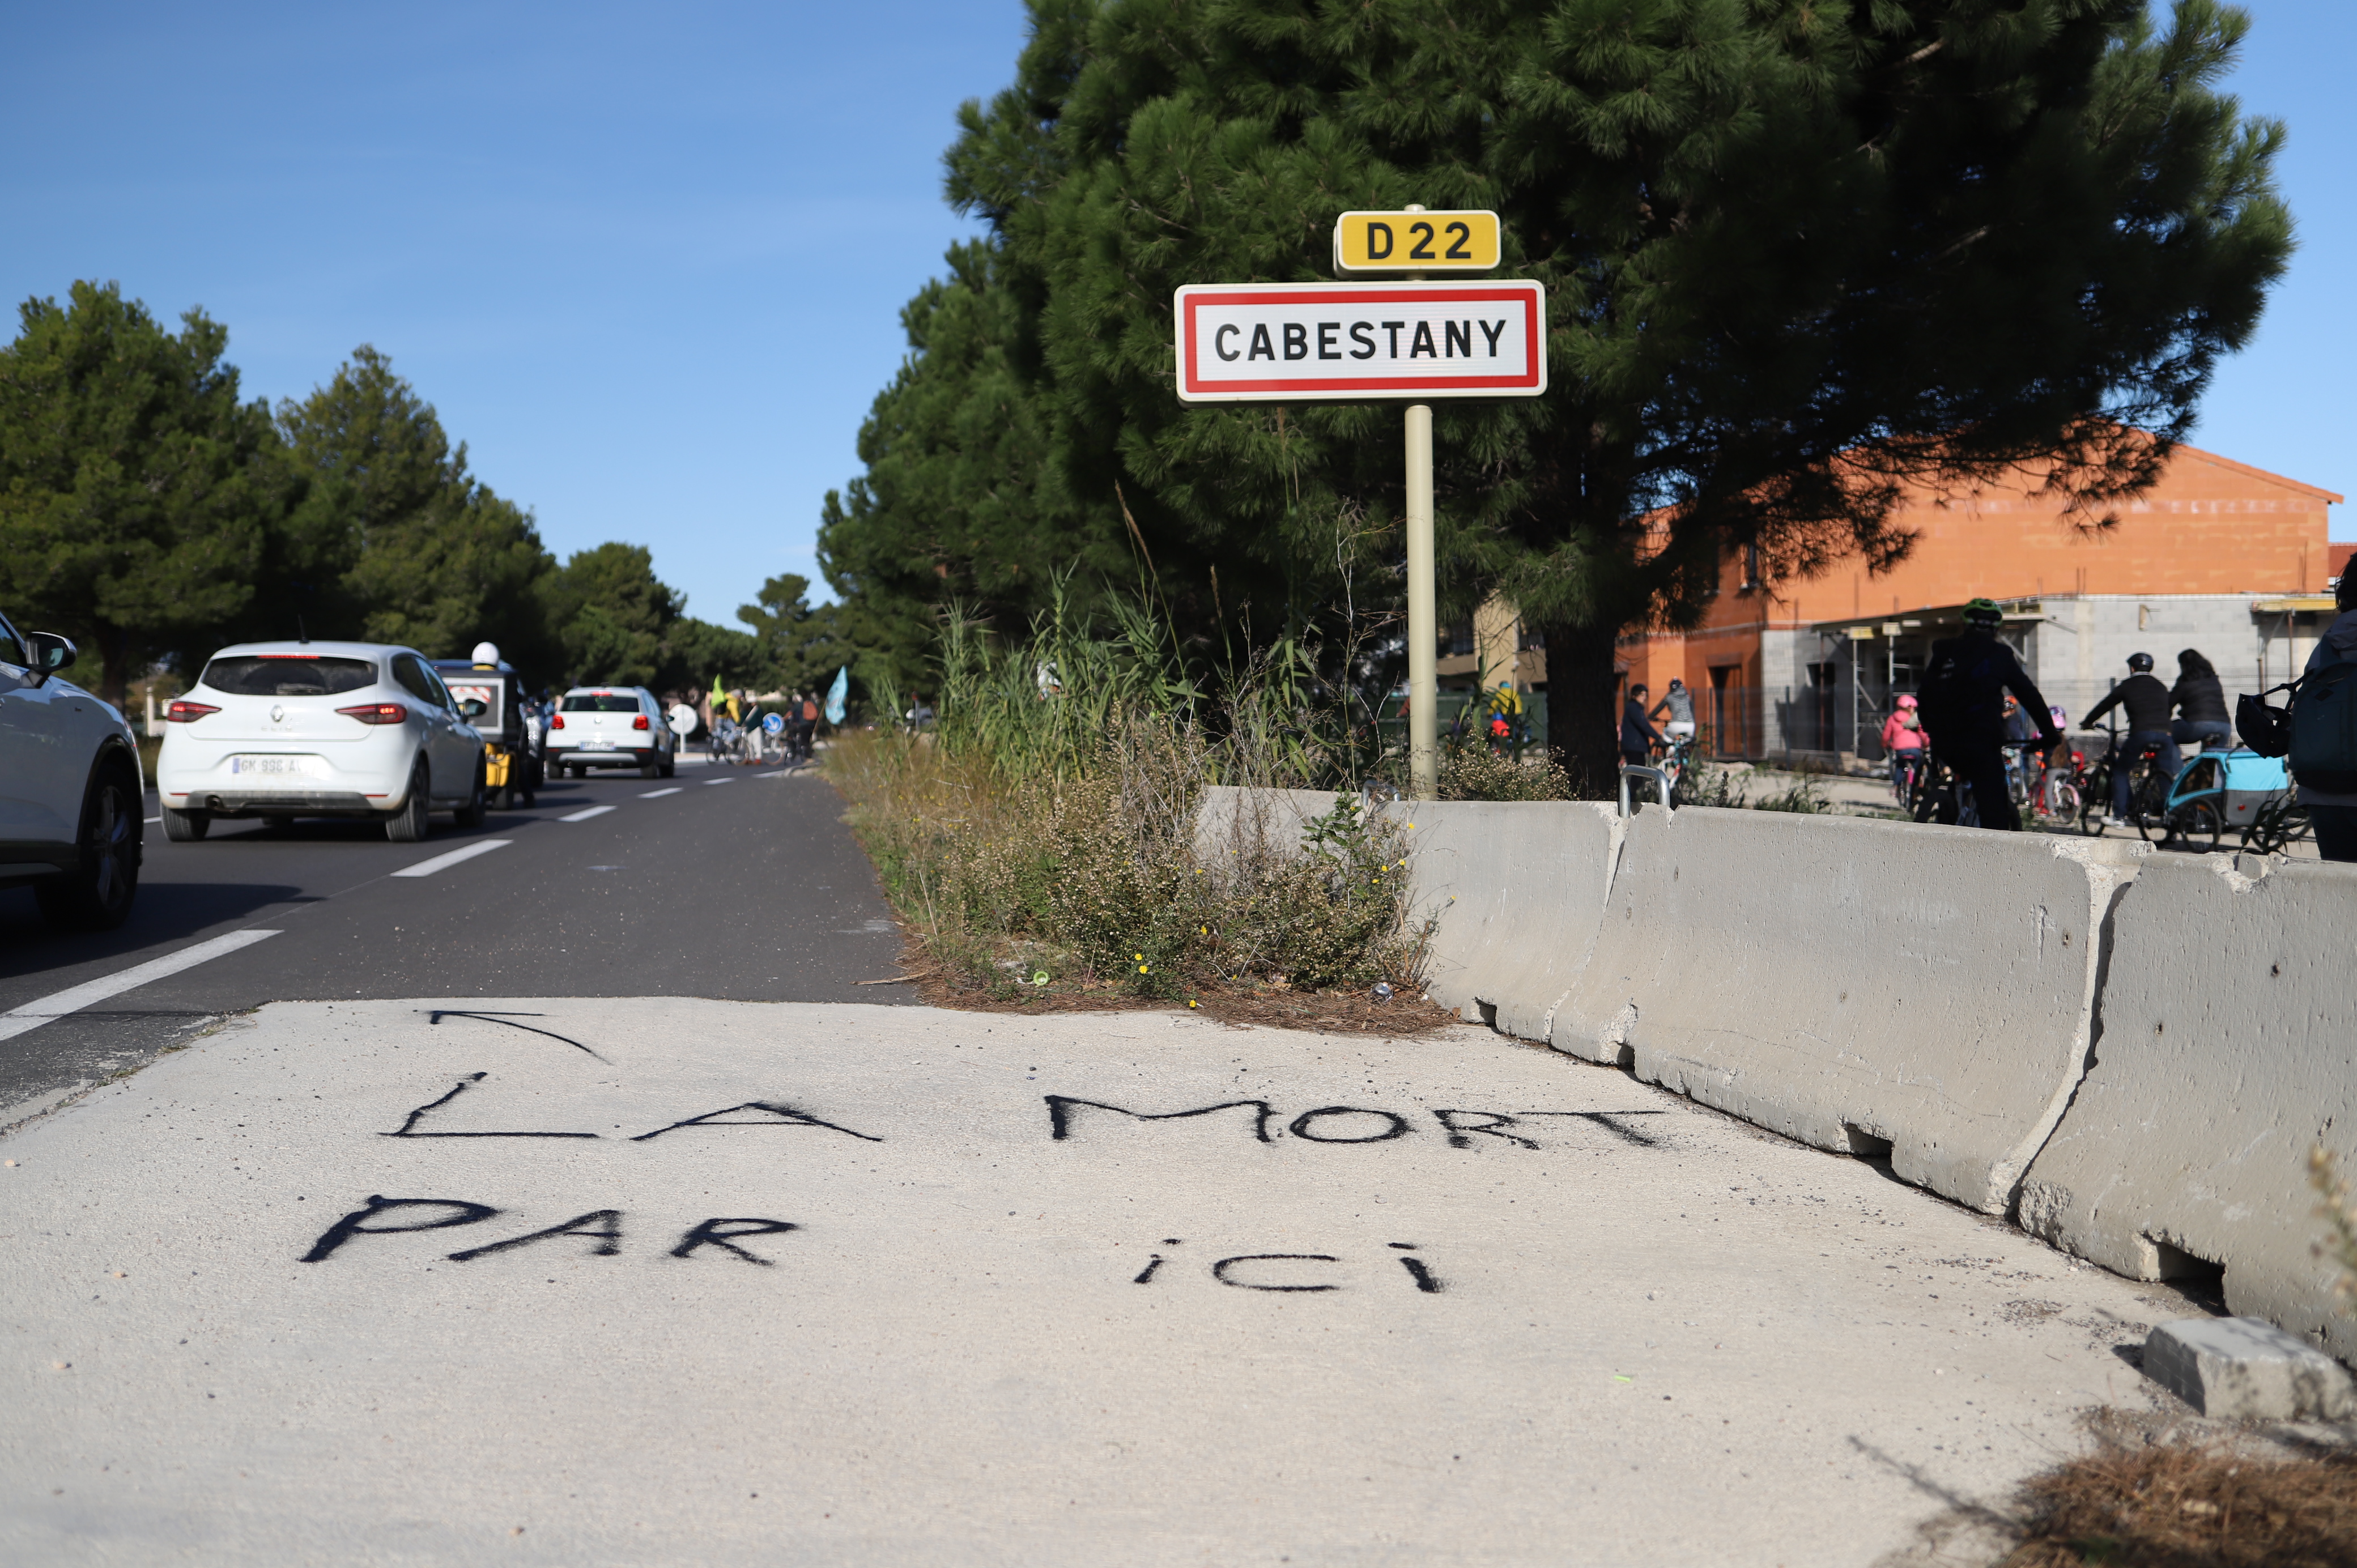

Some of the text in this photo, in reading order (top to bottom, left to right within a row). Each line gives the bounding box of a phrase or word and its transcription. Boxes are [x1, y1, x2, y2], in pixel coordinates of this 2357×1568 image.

[1367, 221, 1471, 260] D 22
[1214, 319, 1507, 362] CABESTANY
[377, 1071, 1667, 1150] LA MORT
[297, 1193, 799, 1267] PAR
